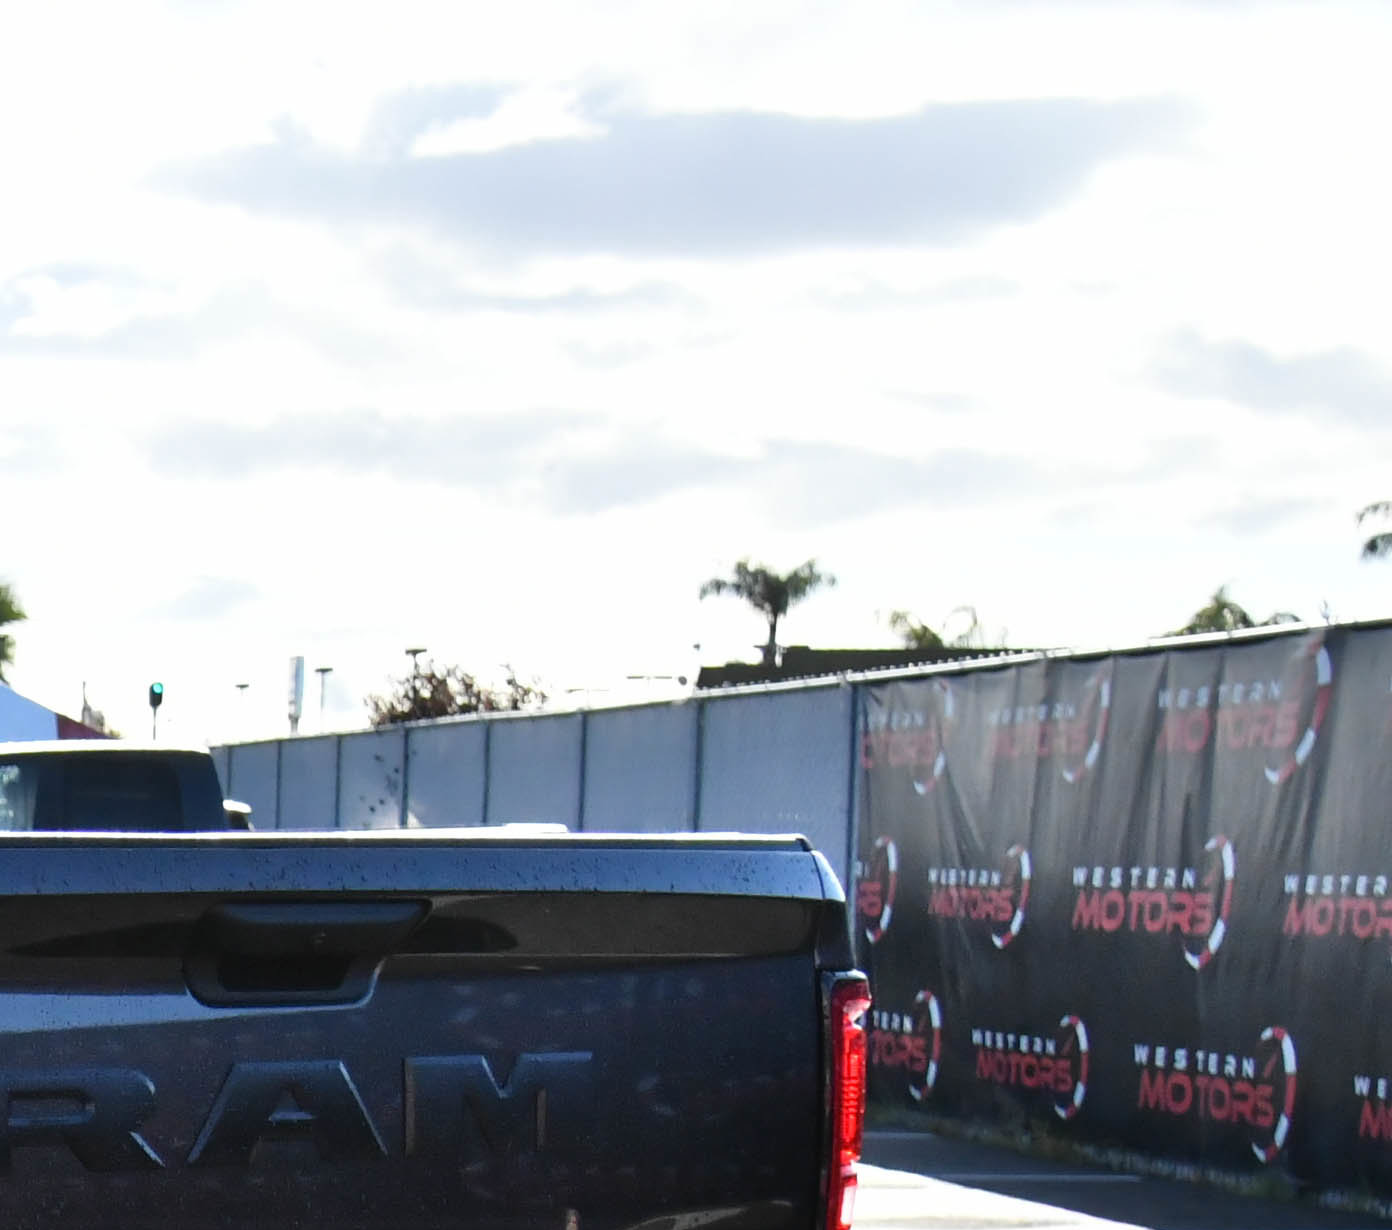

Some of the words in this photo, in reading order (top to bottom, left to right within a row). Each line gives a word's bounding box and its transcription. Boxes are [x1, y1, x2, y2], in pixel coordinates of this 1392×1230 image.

[1072, 866, 1196, 889] WESTERN
[1283, 873, 1388, 897] WESTER
[1072, 888, 1214, 934] MOTORS
[971, 1027, 1056, 1055] WESTERN
[976, 1047, 1073, 1093] MOTORS
[1134, 1042, 1255, 1078] WESTERN
[1138, 1067, 1274, 1128] MOTORS
